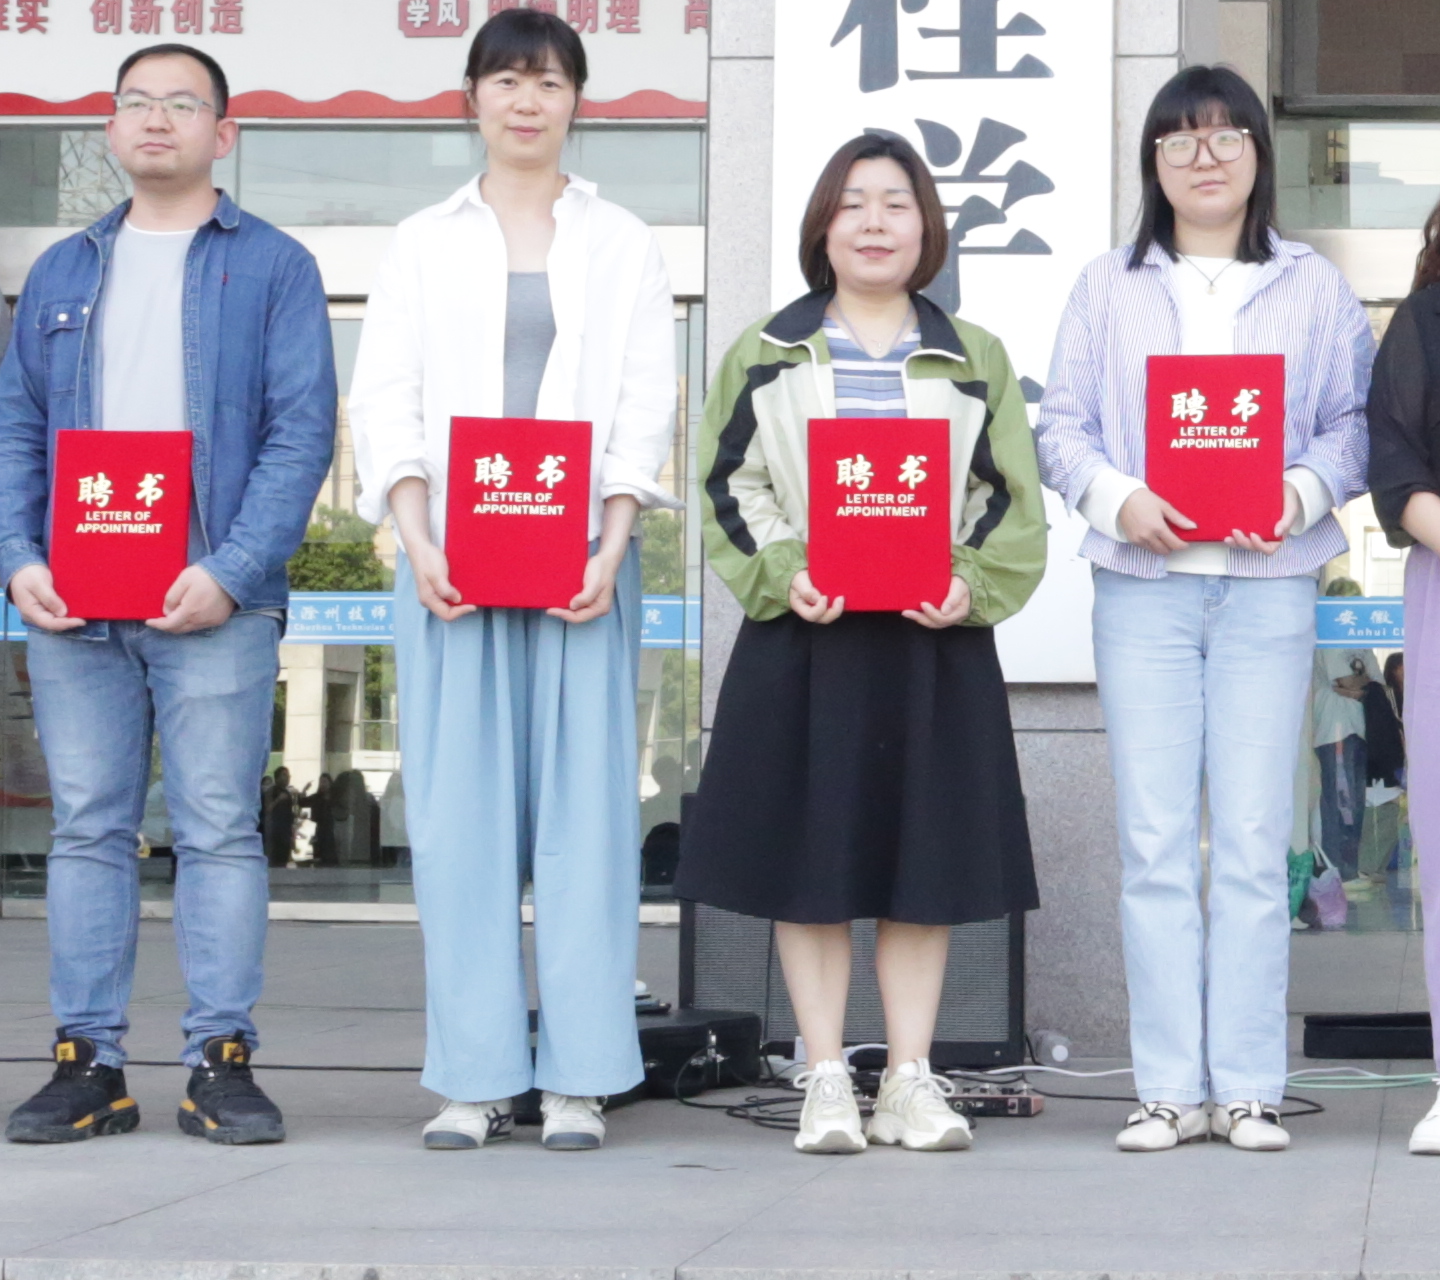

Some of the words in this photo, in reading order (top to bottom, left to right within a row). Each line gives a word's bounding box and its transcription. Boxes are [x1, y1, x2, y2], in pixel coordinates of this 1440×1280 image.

[1172, 389, 1260, 423] 聘书
[1180, 426, 1227, 436] LETTER
[1230, 426, 1247, 436] OF
[1171, 438, 1259, 448] APPOINTMENT
[475, 453, 566, 489] 聘书
[836, 454, 927, 490] 聘书
[78, 472, 164, 508] 聘书
[484, 492, 532, 502] LETTER
[535, 493, 552, 502] OF
[846, 494, 894, 504] LETTER
[897, 494, 914, 504] OF
[474, 504, 565, 515] APPOINTMENT
[837, 506, 927, 516] APPOINTMENT
[86, 511, 132, 521] LETTER
[134, 511, 150, 521] OF
[76, 523, 162, 533] APPOINTMENT
